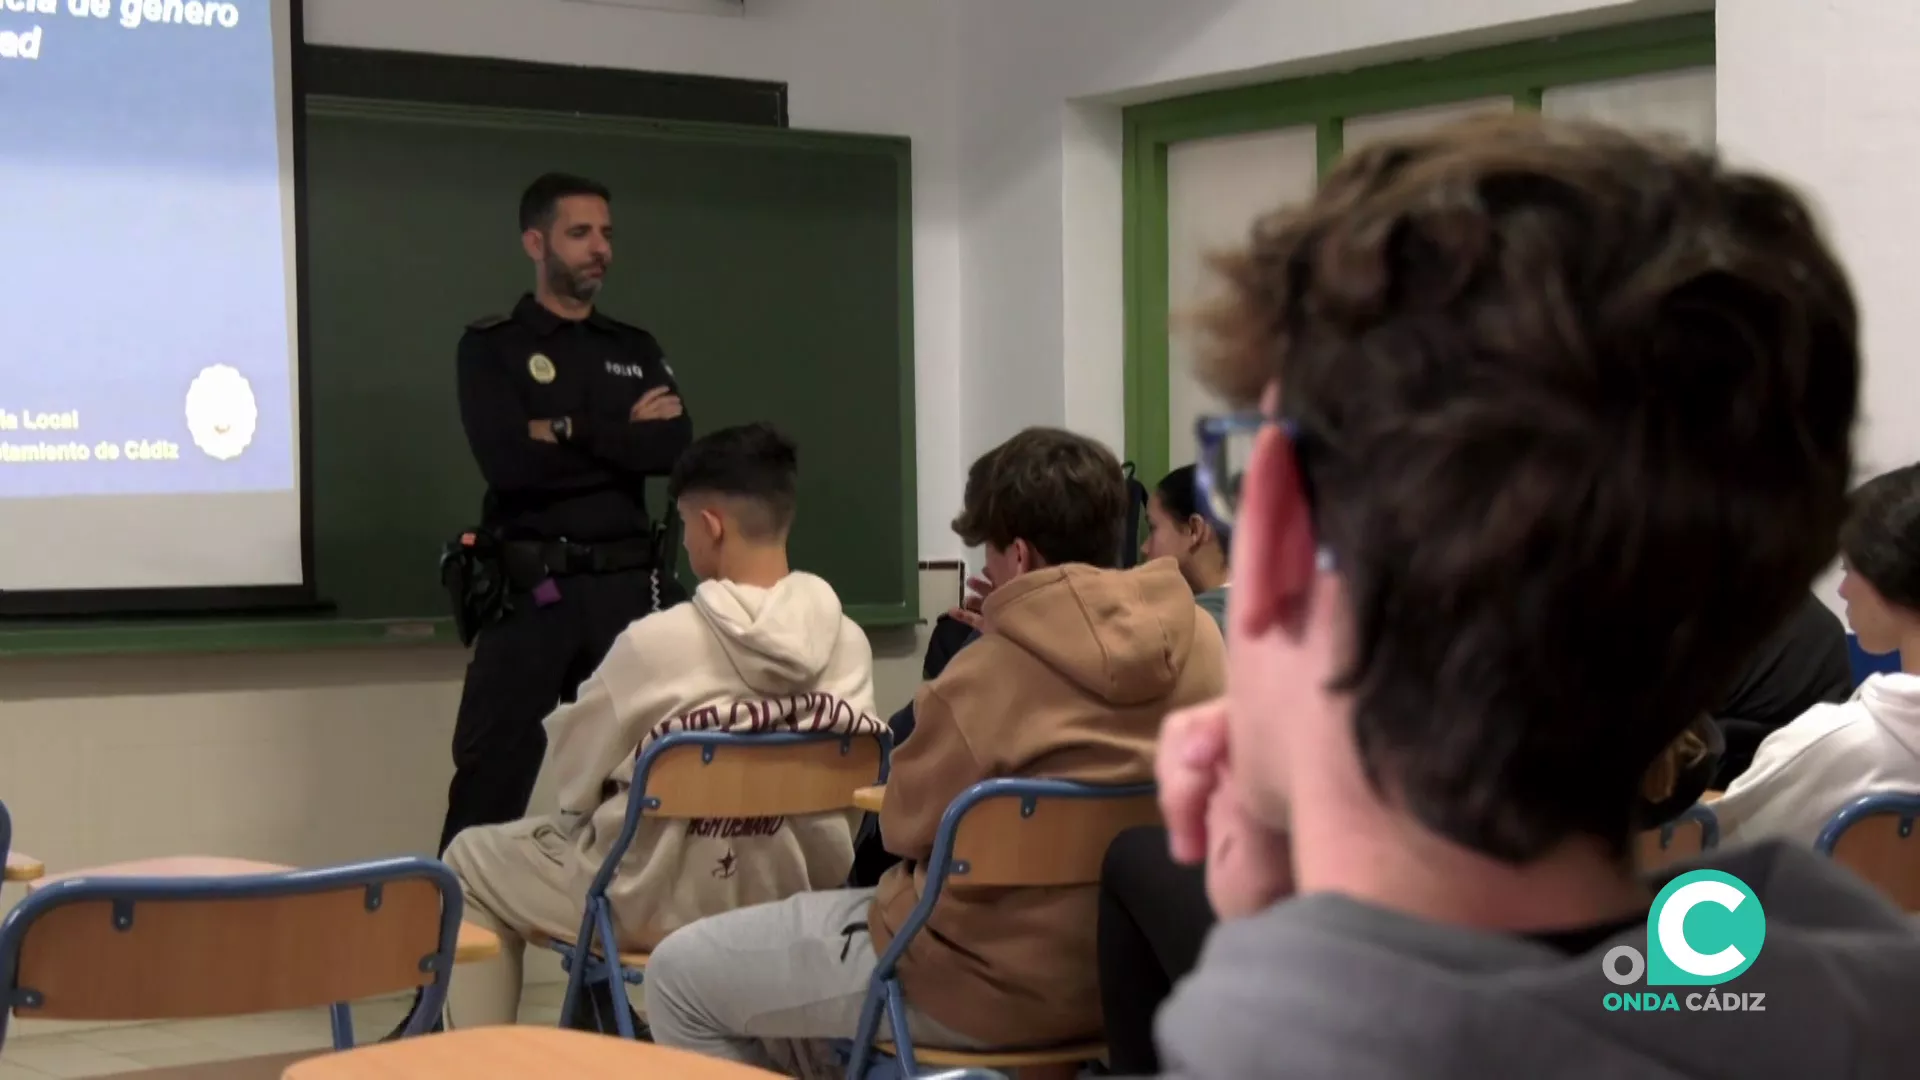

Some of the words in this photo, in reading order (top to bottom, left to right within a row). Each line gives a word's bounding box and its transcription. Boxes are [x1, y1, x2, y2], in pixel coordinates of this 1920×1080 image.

[23, 409, 79, 430] Local
[0, 441, 90, 461] tamiento
[94, 441, 119, 460] de
[124, 439, 179, 460] Cádiz
